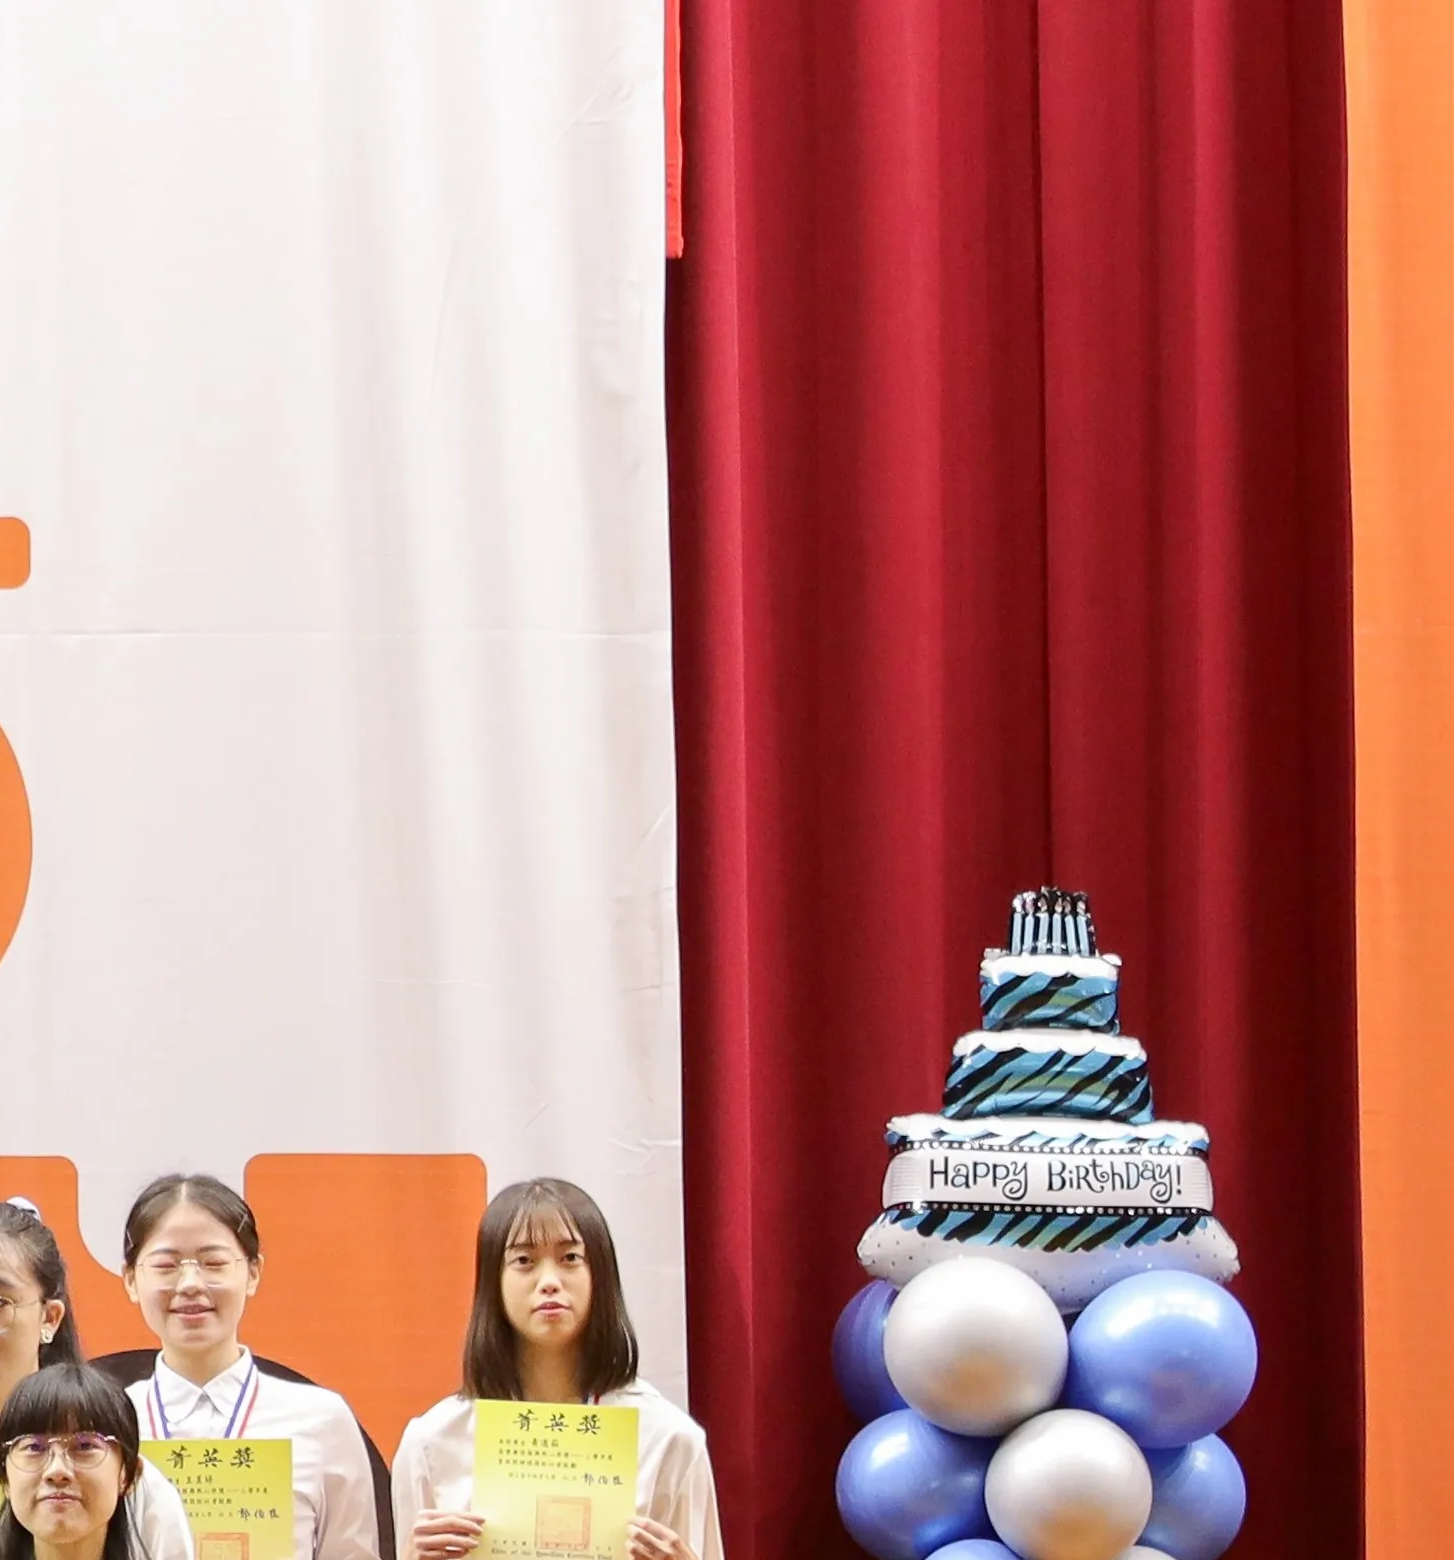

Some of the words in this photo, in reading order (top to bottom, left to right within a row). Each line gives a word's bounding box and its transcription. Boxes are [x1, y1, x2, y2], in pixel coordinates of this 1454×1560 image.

[929, 1156, 1028, 1200] Happy
[513, 1409, 601, 1435] 菁英獎
[166, 1446, 255, 1469] 菁英獎
